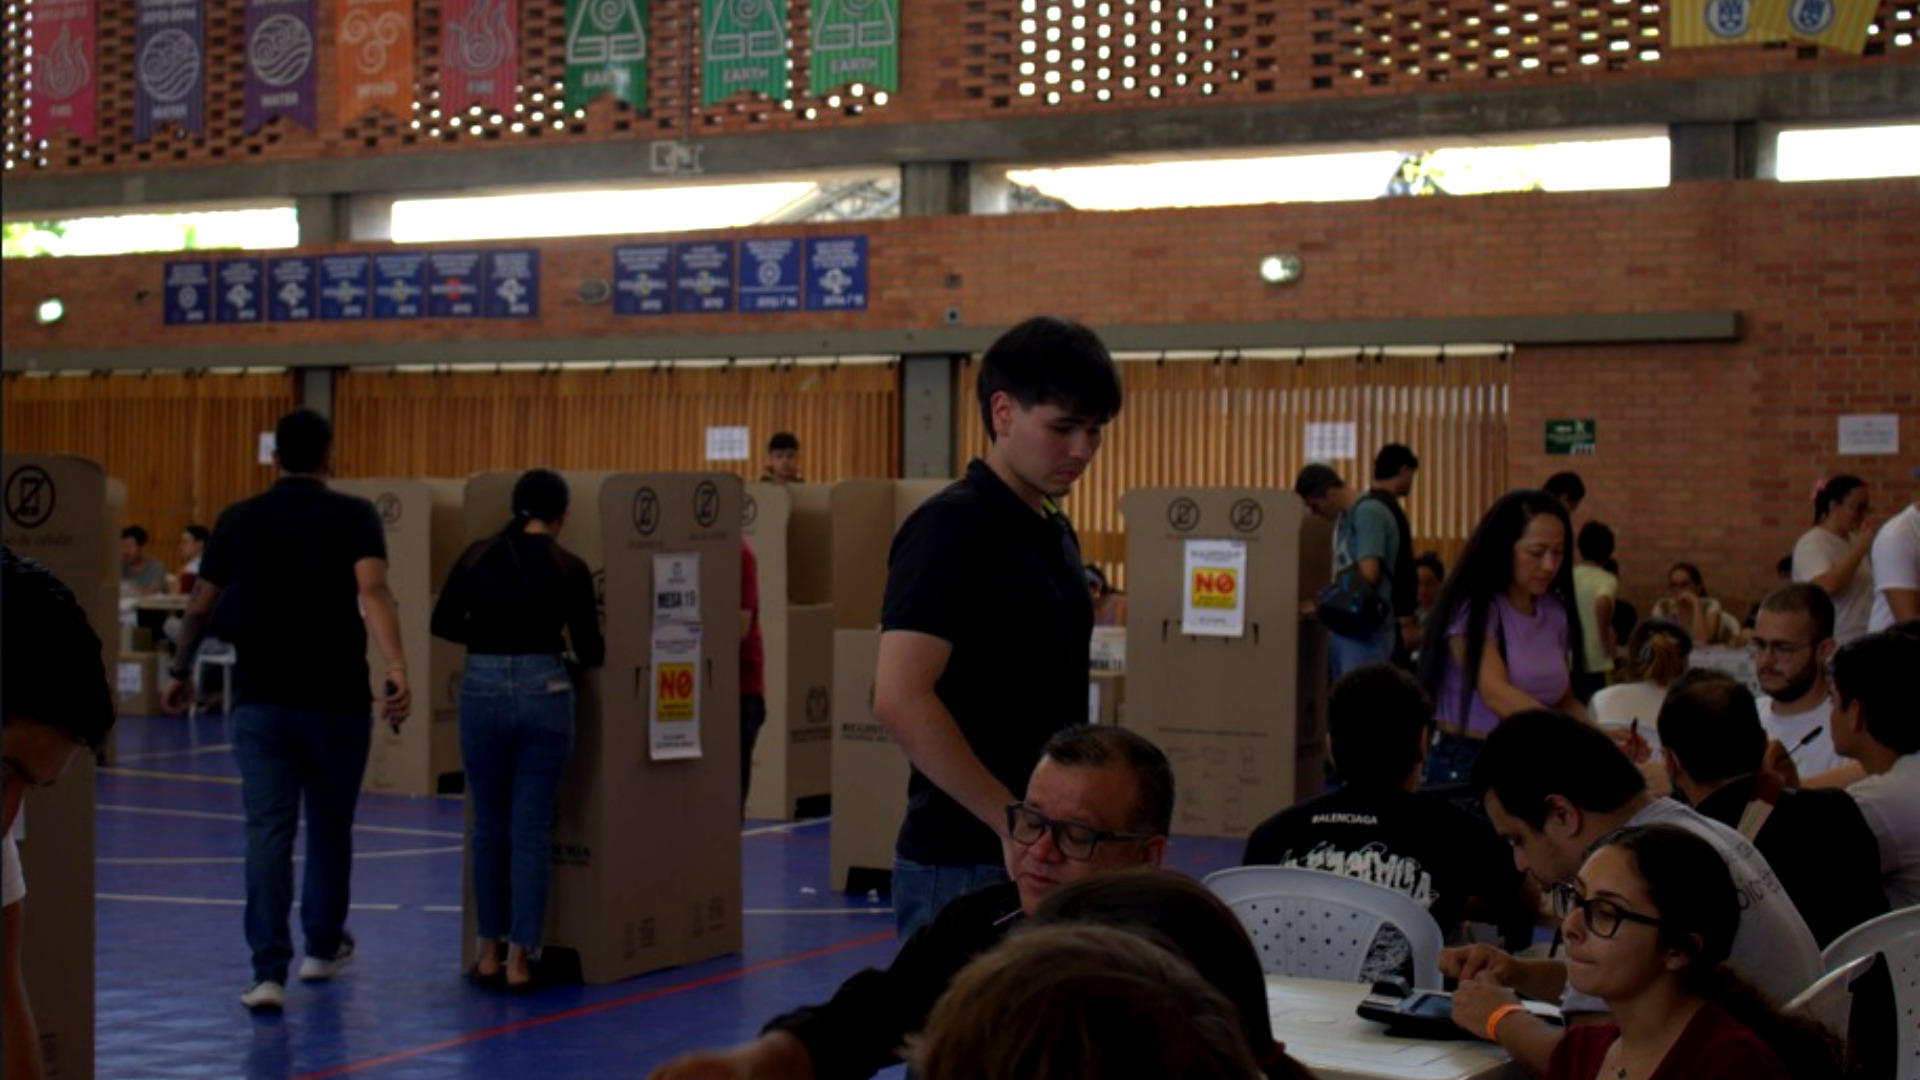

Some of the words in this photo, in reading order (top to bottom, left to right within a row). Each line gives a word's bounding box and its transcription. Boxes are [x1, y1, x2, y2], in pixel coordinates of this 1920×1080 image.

[829, 56, 879, 74] EARTH
[581, 68, 631, 88] EARTH
[722, 66, 770, 84] EARTH
[1196, 573, 1236, 595] NO
[657, 591, 682, 608] MESA
[660, 668, 693, 700] NO
[1311, 811, 1379, 826] BALENCIAGA
